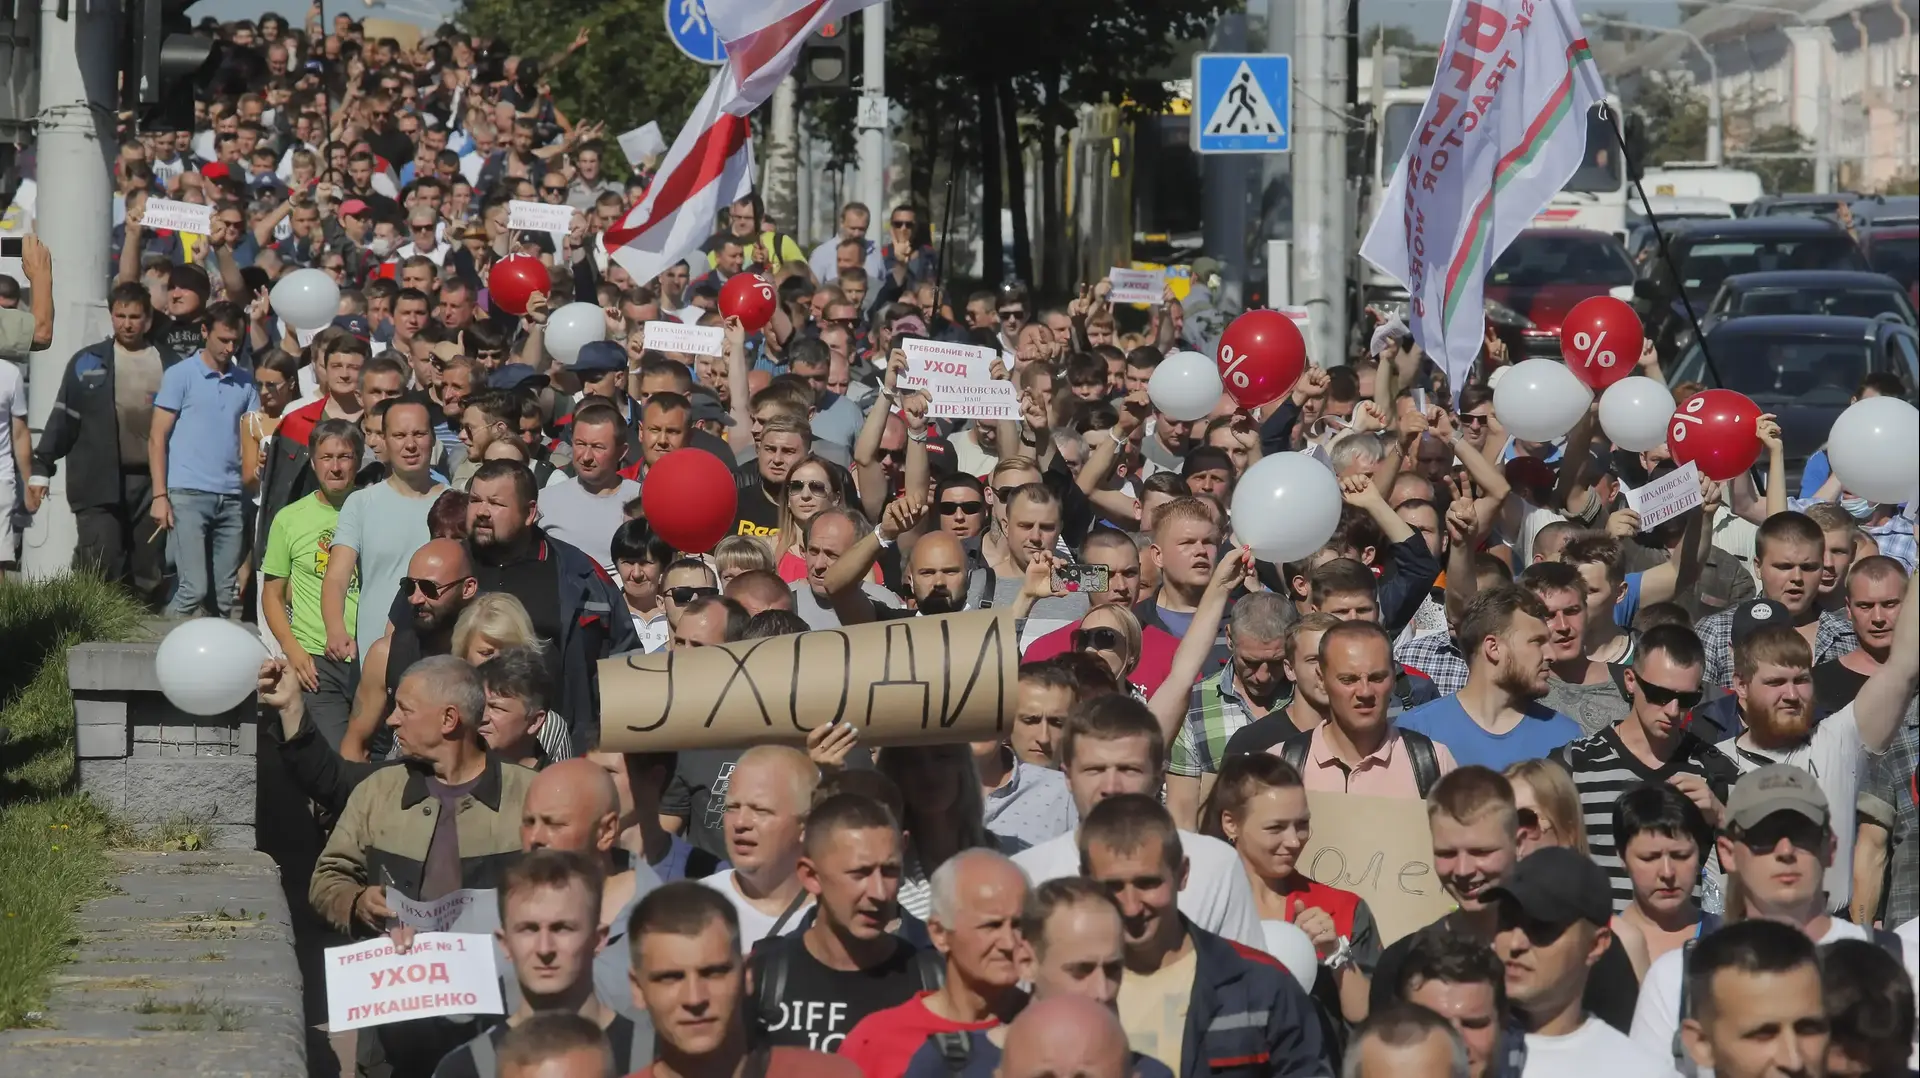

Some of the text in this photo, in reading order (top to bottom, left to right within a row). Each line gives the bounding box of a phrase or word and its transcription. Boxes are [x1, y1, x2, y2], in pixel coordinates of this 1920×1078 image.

[909, 344, 962, 357] ТРЕБОВАНИЕ
[977, 349, 982, 359] 1
[924, 359, 967, 378] УХОД
[936, 384, 1011, 395] ТИХАНОВСКАЯ
[934, 404, 1012, 416] ПРЕЗИДЕНТ
[1639, 471, 1692, 504] ТИХАНОВСКАЯ
[1643, 491, 1697, 527] ПРЕЗИДЕНТ
[627, 616, 1005, 733] УХОДИ
[338, 941, 433, 966] ТРЕБОВНИЕ
[456, 938, 467, 952] 1
[369, 962, 450, 990] УХОД
[346, 992, 478, 1022] ЛУКАШЕНКО
